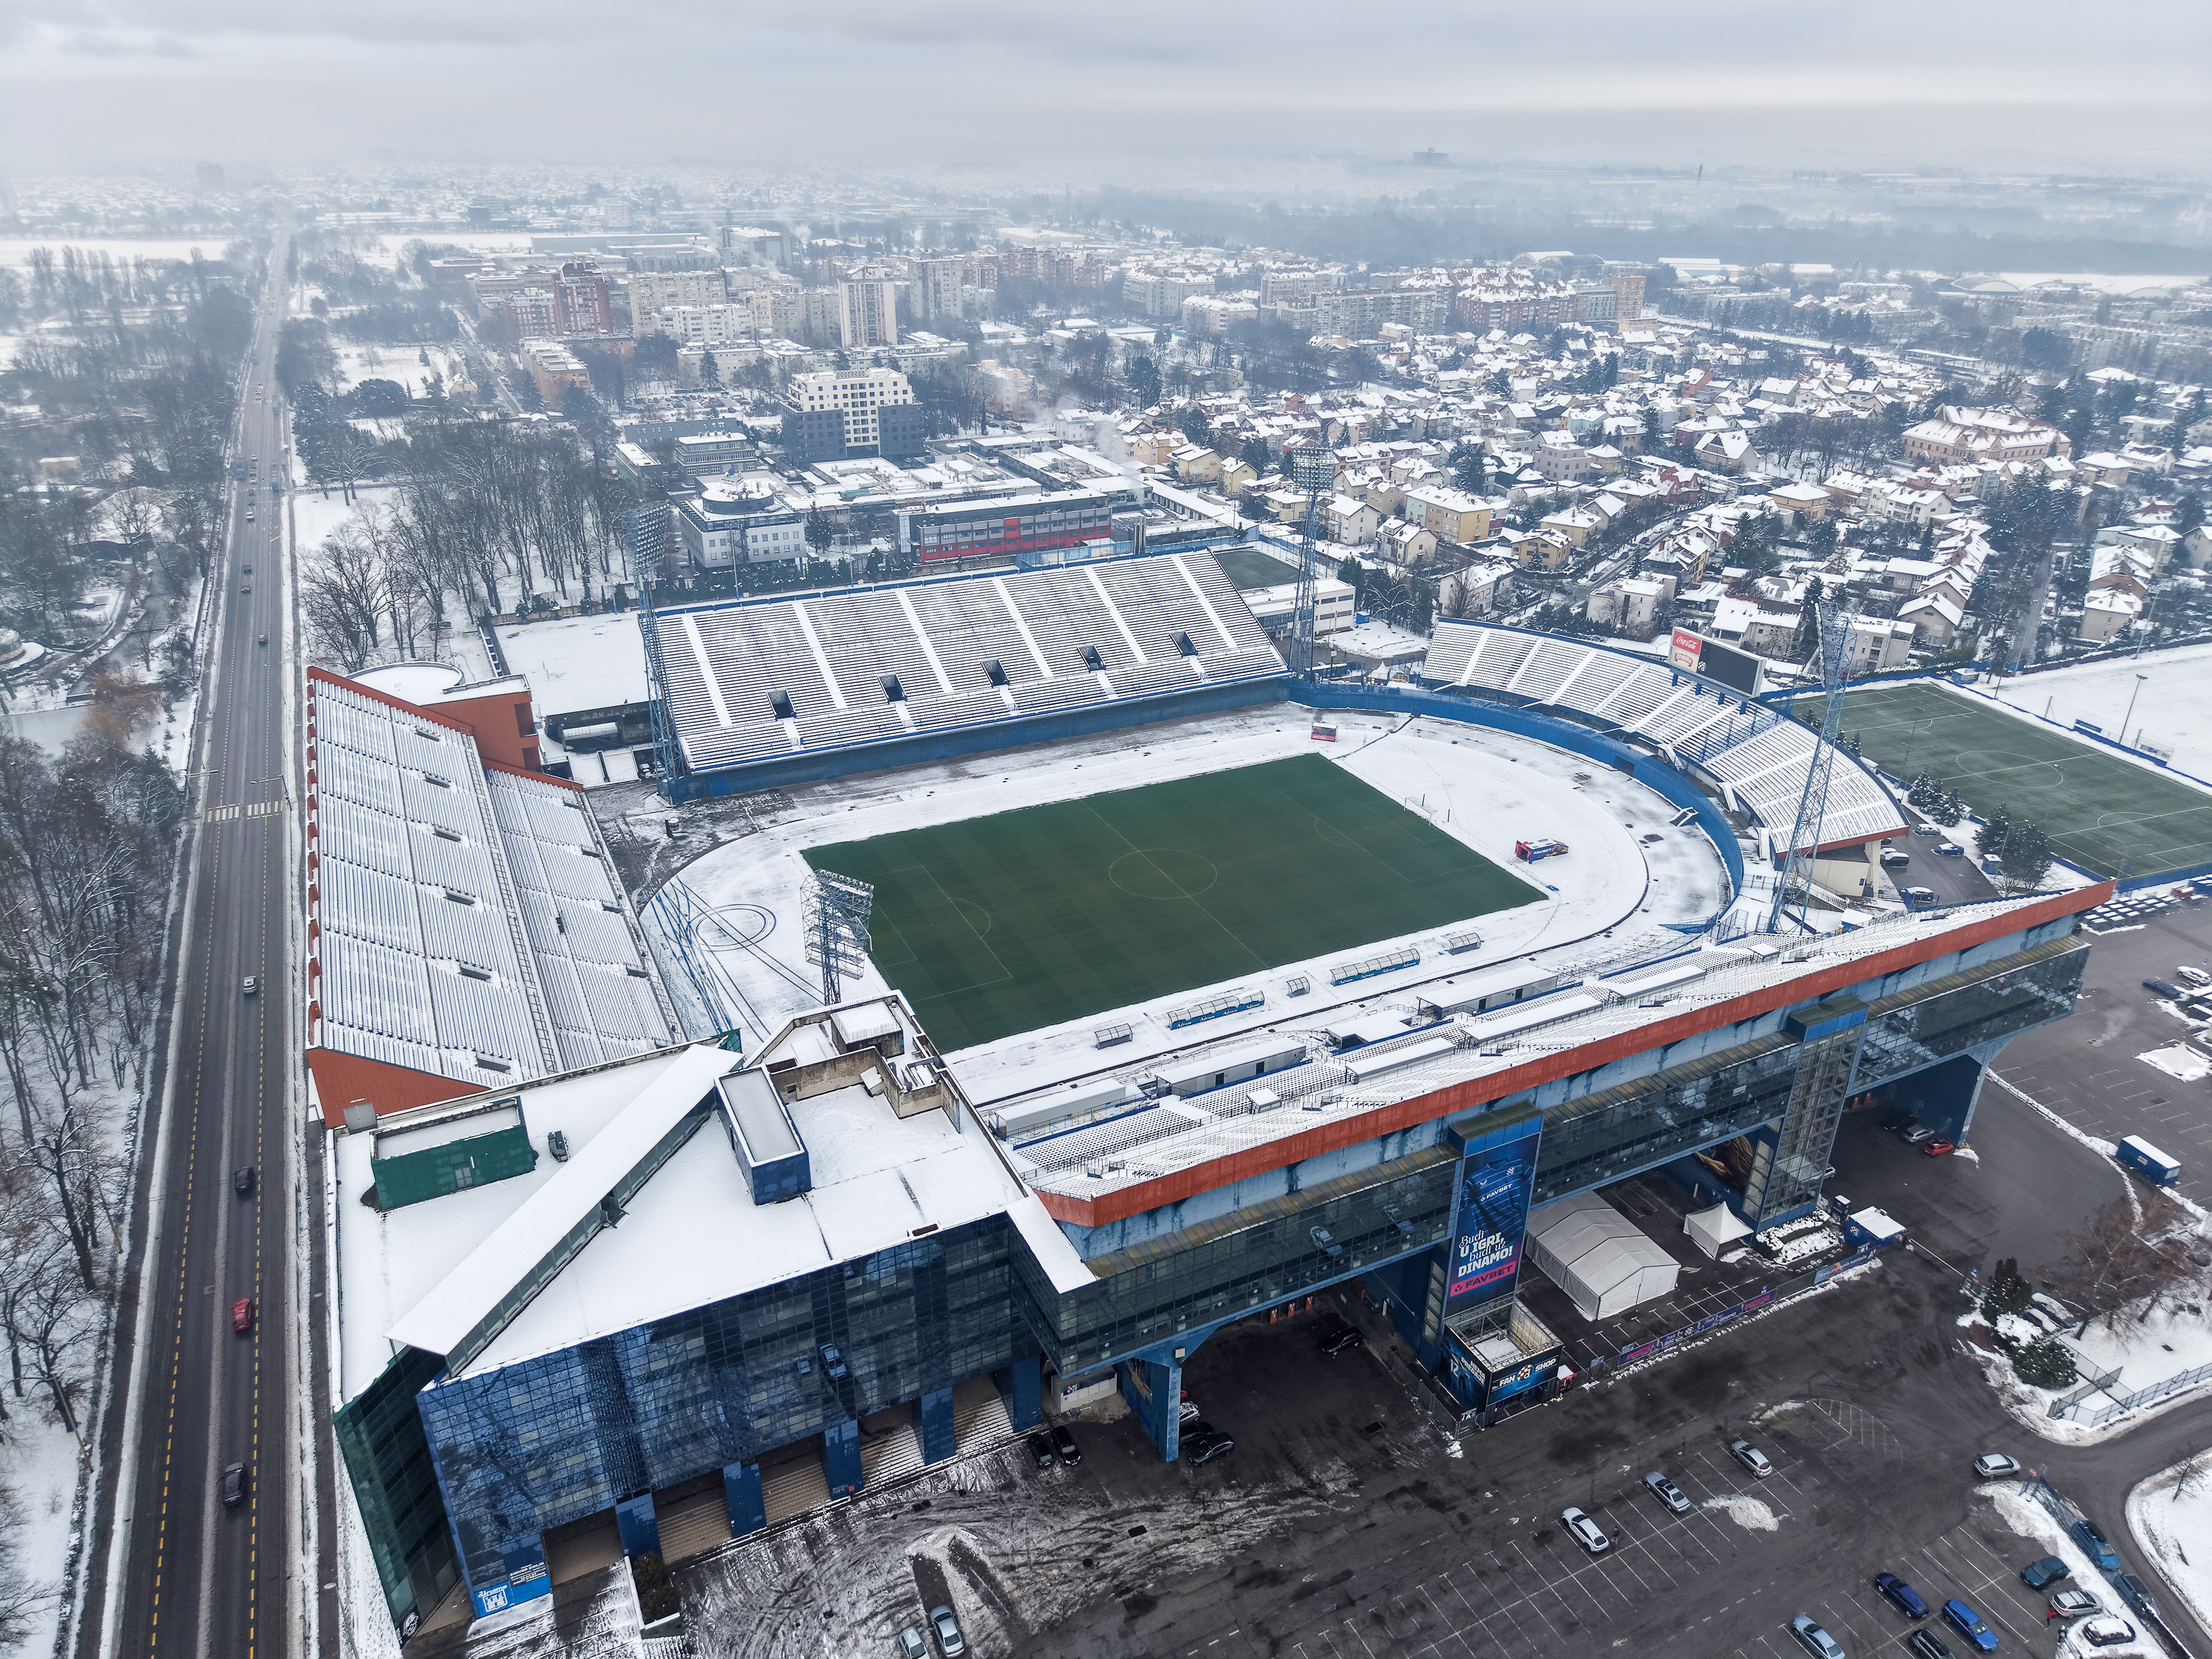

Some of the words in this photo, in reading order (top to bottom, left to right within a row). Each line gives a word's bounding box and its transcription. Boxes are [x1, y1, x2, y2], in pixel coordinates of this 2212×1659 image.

[1486, 1183, 1512, 1199] FAVBET
[1458, 1229, 1484, 1249] Budi
[1460, 1245, 1469, 1258] U
[1472, 1232, 1504, 1254] IGRI,
[1458, 1245, 1514, 1277] DINAMO!
[1469, 1245, 1491, 1262] budi
[1465, 1264, 1514, 1288] FAVBET
[1461, 1357, 1485, 1384] PREDAJE
[1470, 1360, 1486, 1380] NEMA
[1499, 1374, 1516, 1387] FAN
[1535, 1358, 1557, 1373] SHOP
[510, 1567, 528, 1577] SJEVER
[529, 1561, 545, 1570] DOLJE
[478, 1584, 508, 1598] dinamo
